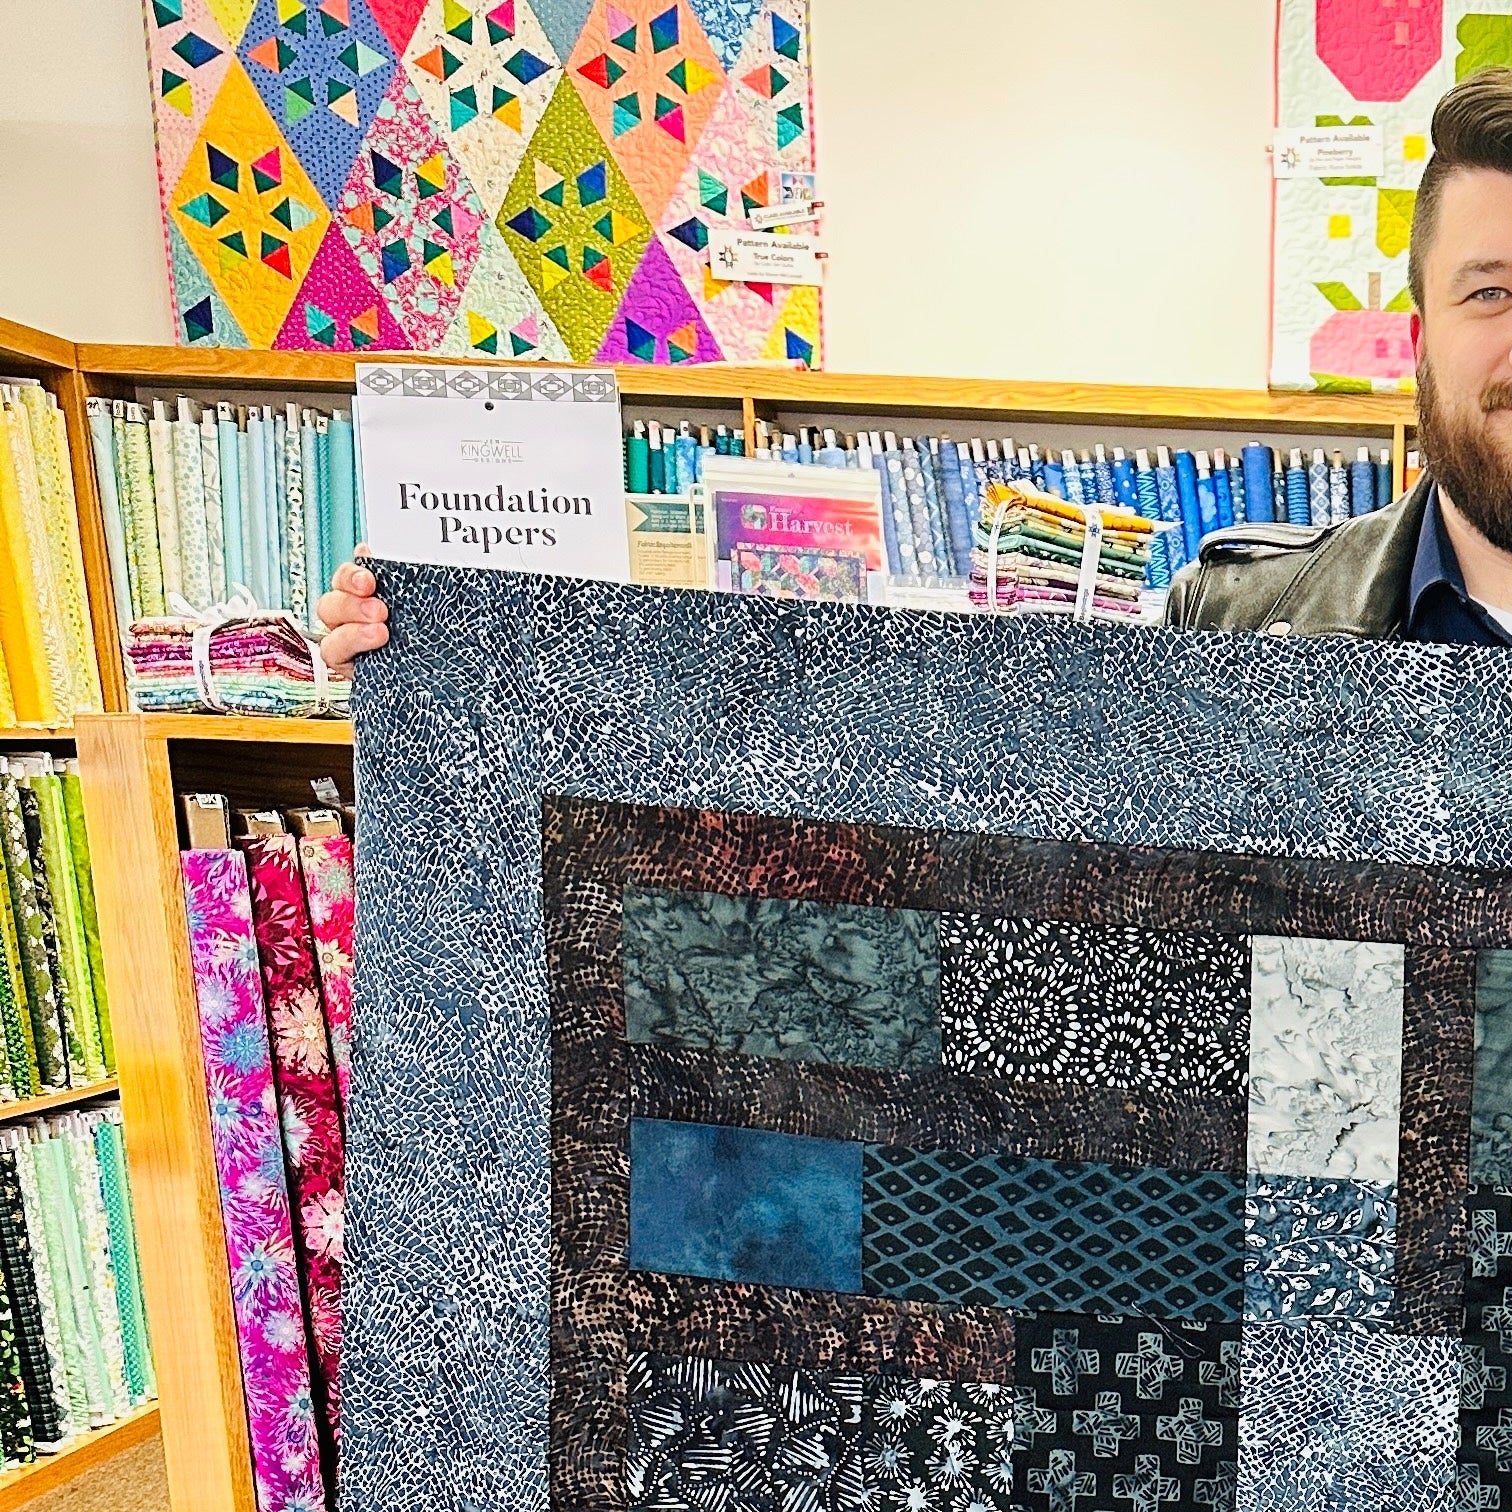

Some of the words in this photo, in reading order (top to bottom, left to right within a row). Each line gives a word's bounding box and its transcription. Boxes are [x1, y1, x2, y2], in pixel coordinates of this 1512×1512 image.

[737, 238, 769, 248] Pattern
[771, 241, 810, 251] Available
[771, 254, 794, 262] Colors
[460, 443, 523, 459] KINGWELL
[398, 482, 593, 516] Foundation
[768, 511, 854, 537] Harvest
[439, 516, 557, 554] Papers
